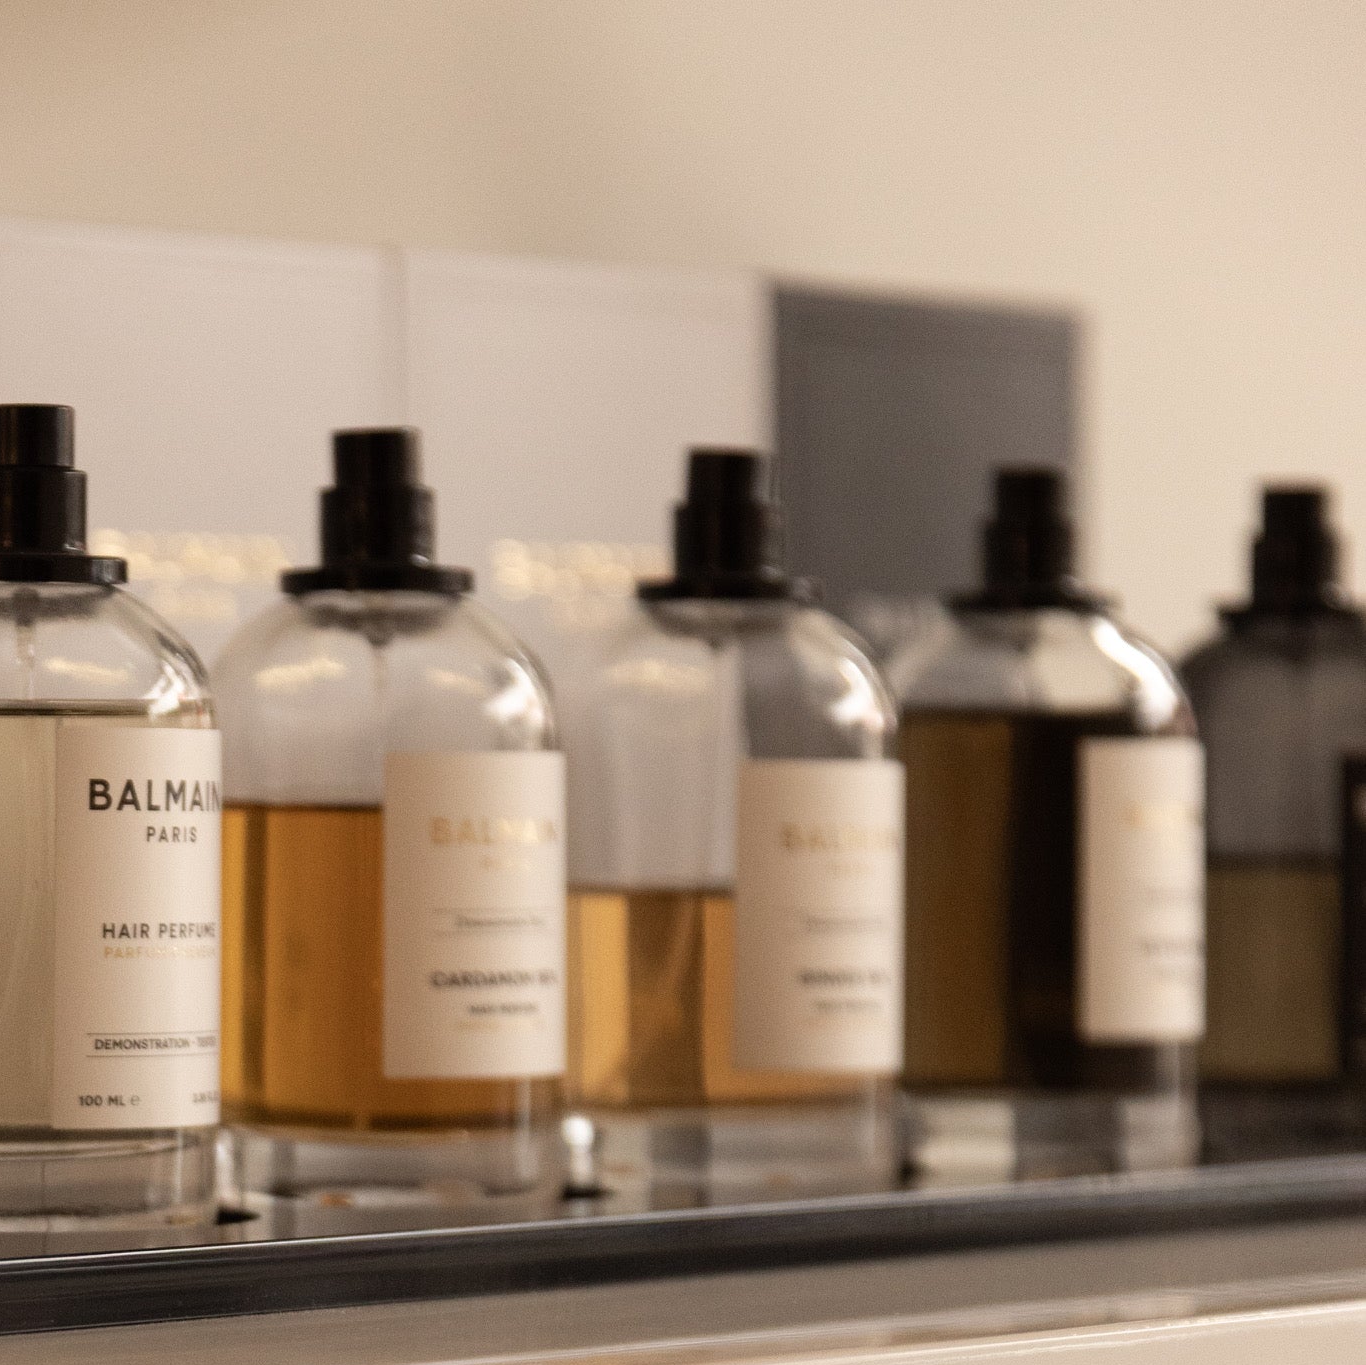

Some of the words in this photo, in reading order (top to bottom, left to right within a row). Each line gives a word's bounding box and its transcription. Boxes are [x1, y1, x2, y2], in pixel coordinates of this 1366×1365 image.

[146, 826, 198, 843] PARIS
[102, 922, 150, 939] HAIR
[158, 921, 216, 939] PERFUME
[94, 1038, 190, 1050] DEMONSTRATION
[80, 1095, 103, 1107] 100
[107, 1094, 126, 1107] ML
